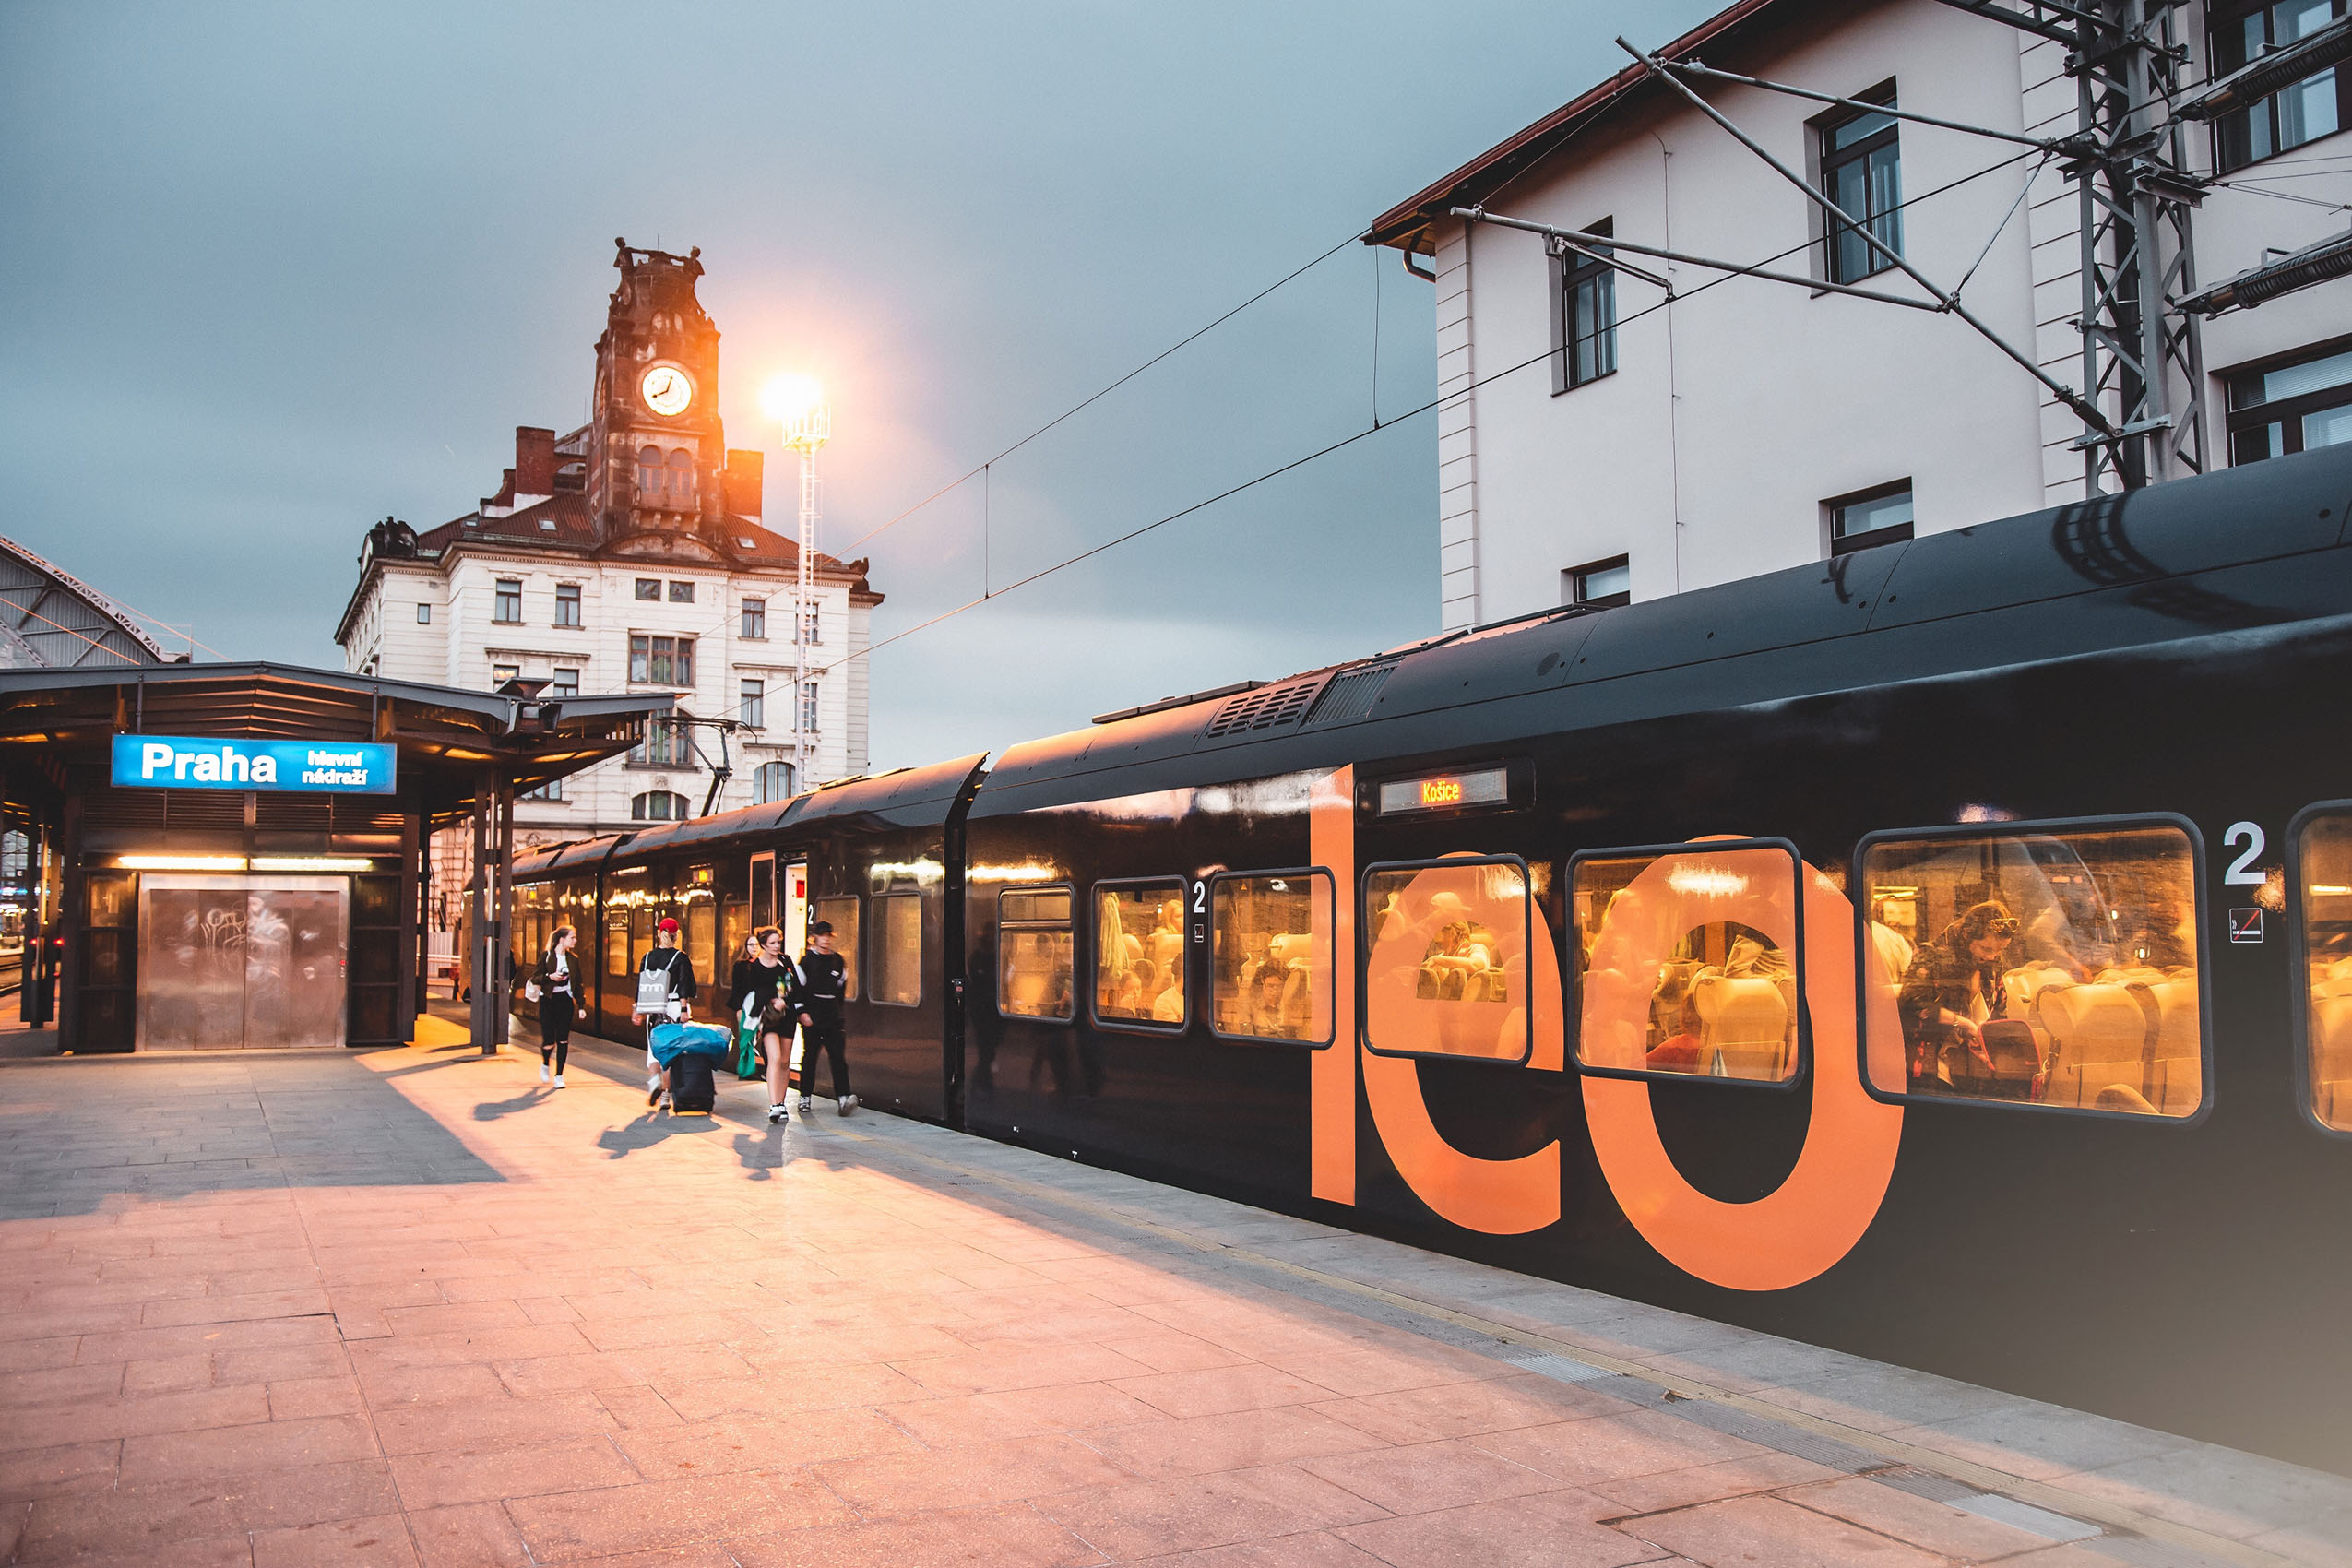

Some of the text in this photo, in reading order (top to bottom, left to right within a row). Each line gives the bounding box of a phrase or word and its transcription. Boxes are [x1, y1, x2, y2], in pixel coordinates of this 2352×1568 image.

[141, 743, 277, 783] Praha
[307, 750, 363, 767] hlavní
[302, 768, 368, 785] nádraží
[1423, 781, 1459, 802] Košice
[2224, 821, 2266, 885] 2
[1194, 881, 1206, 913] 2
[808, 904, 814, 925] 2
